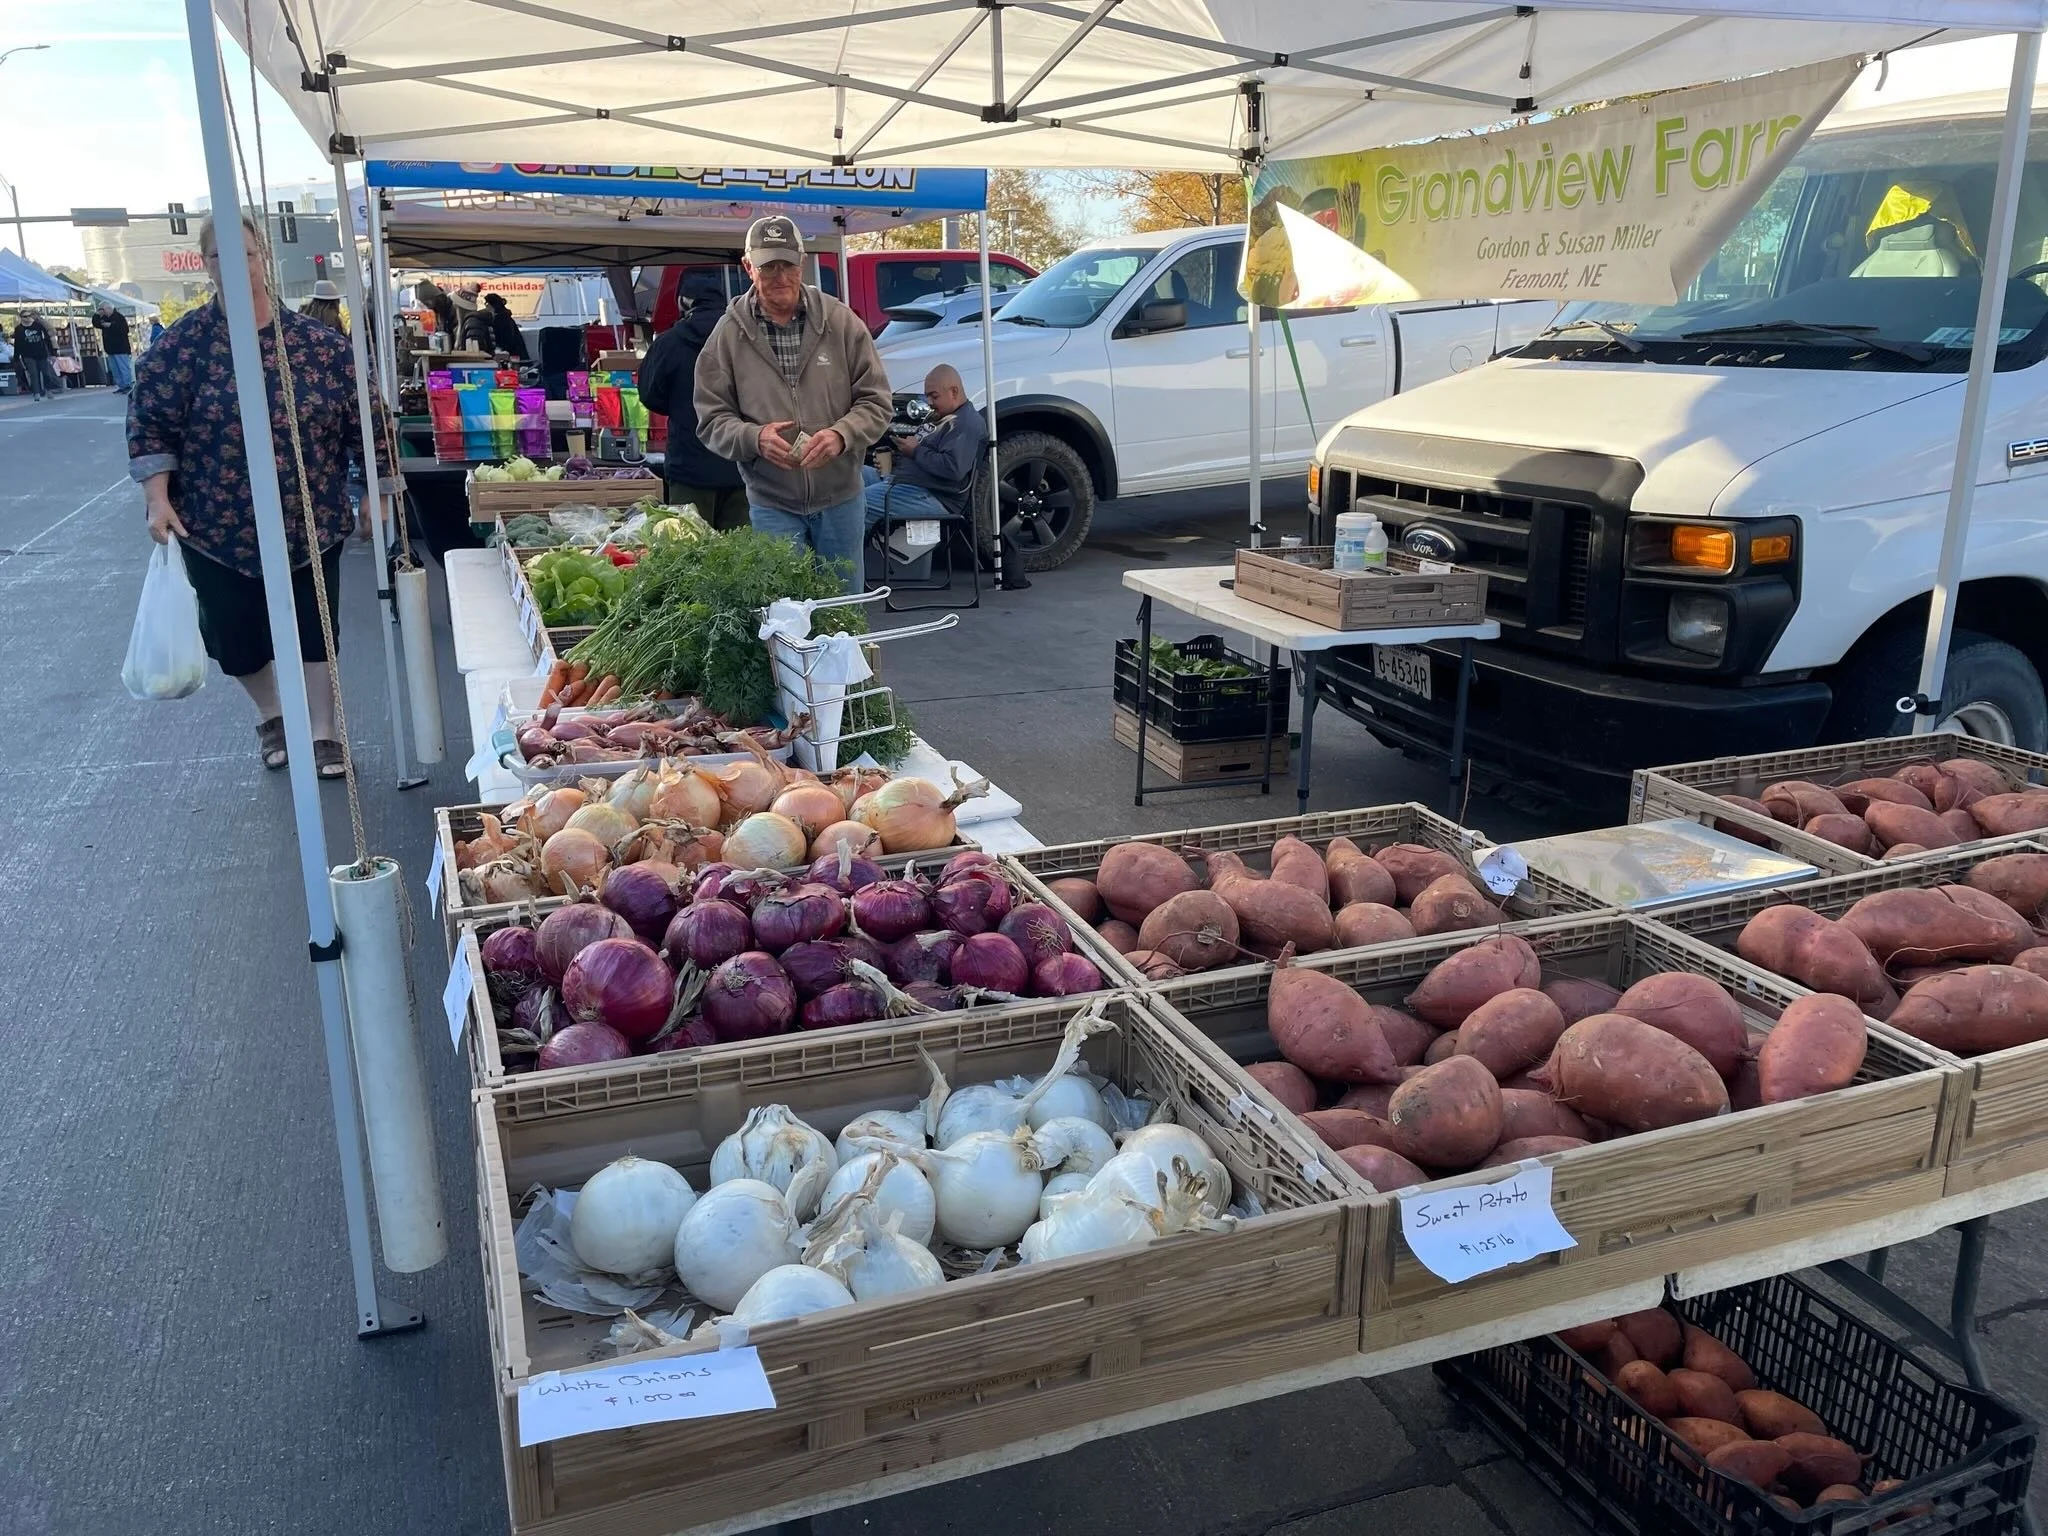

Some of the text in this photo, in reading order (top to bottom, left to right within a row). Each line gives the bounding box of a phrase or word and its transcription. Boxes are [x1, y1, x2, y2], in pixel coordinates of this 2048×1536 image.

[1375, 142, 1633, 225] Grandview
[1477, 226, 1662, 261] Gordon & Susan Miller
[481, 282, 545, 291] Enchiladas
[1500, 264, 1607, 291] Fremont, NE
[1378, 650, 1428, 693] 6-4534R
[1416, 1182, 1528, 1228] Sweet Potato
[618, 1367, 712, 1387] Onions
